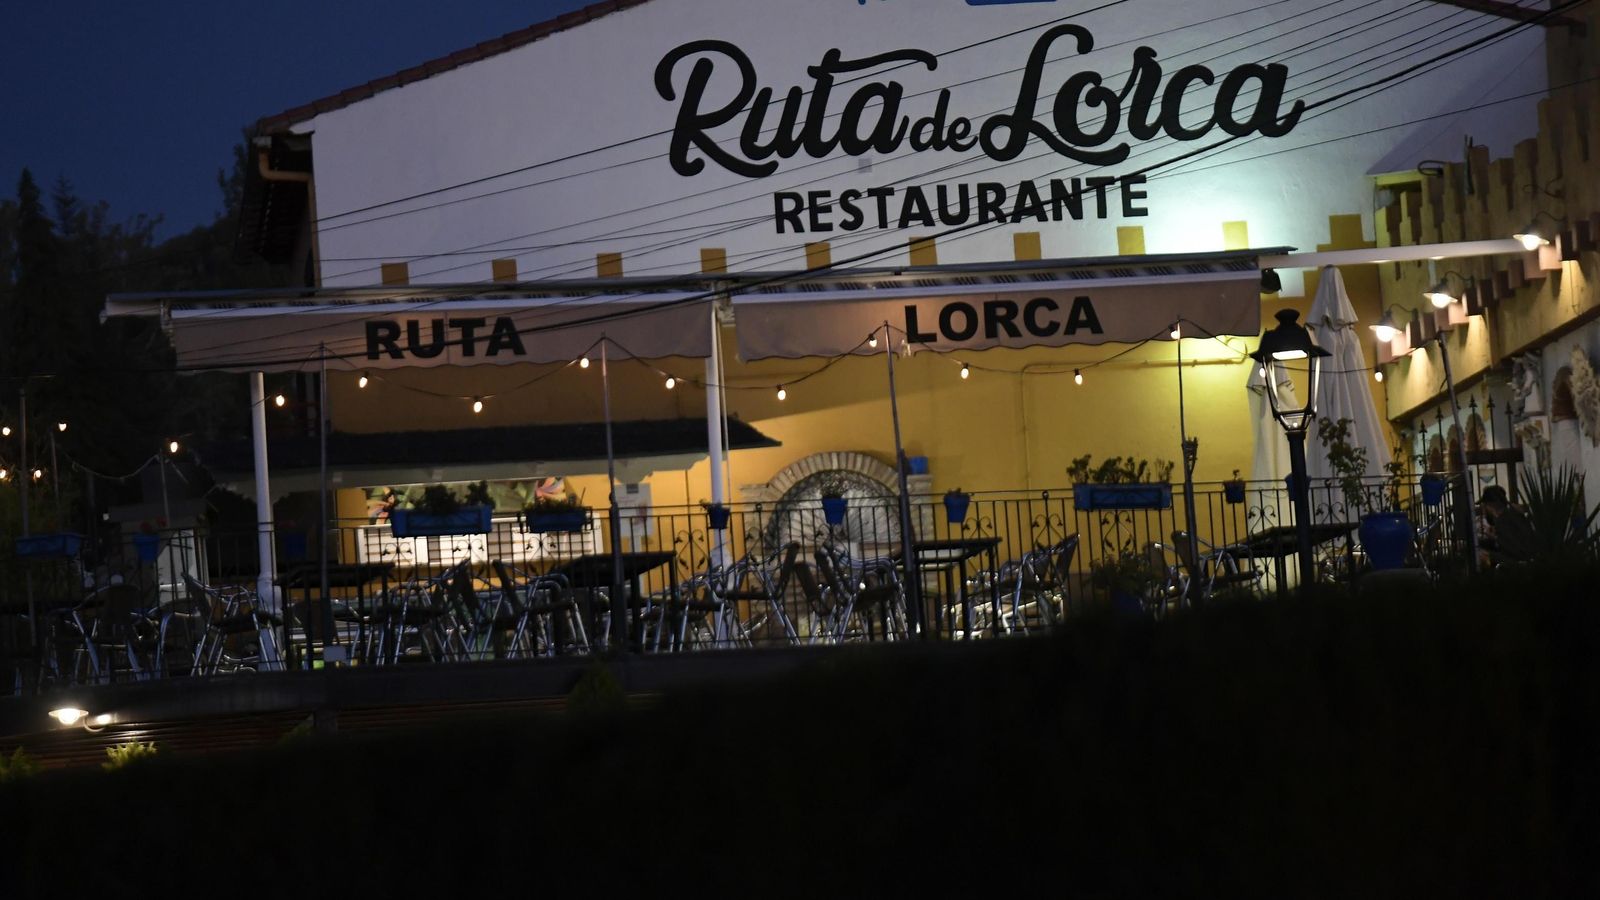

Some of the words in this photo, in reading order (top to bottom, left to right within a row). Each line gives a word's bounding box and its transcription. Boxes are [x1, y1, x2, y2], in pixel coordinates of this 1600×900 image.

[655, 40, 937, 177] Ruta
[910, 89, 978, 152] de
[979, 24, 1305, 165] Lorca
[774, 174, 1148, 234] RESTAURANTE
[365, 316, 527, 360] RUTA
[905, 296, 1104, 343] LORCA
